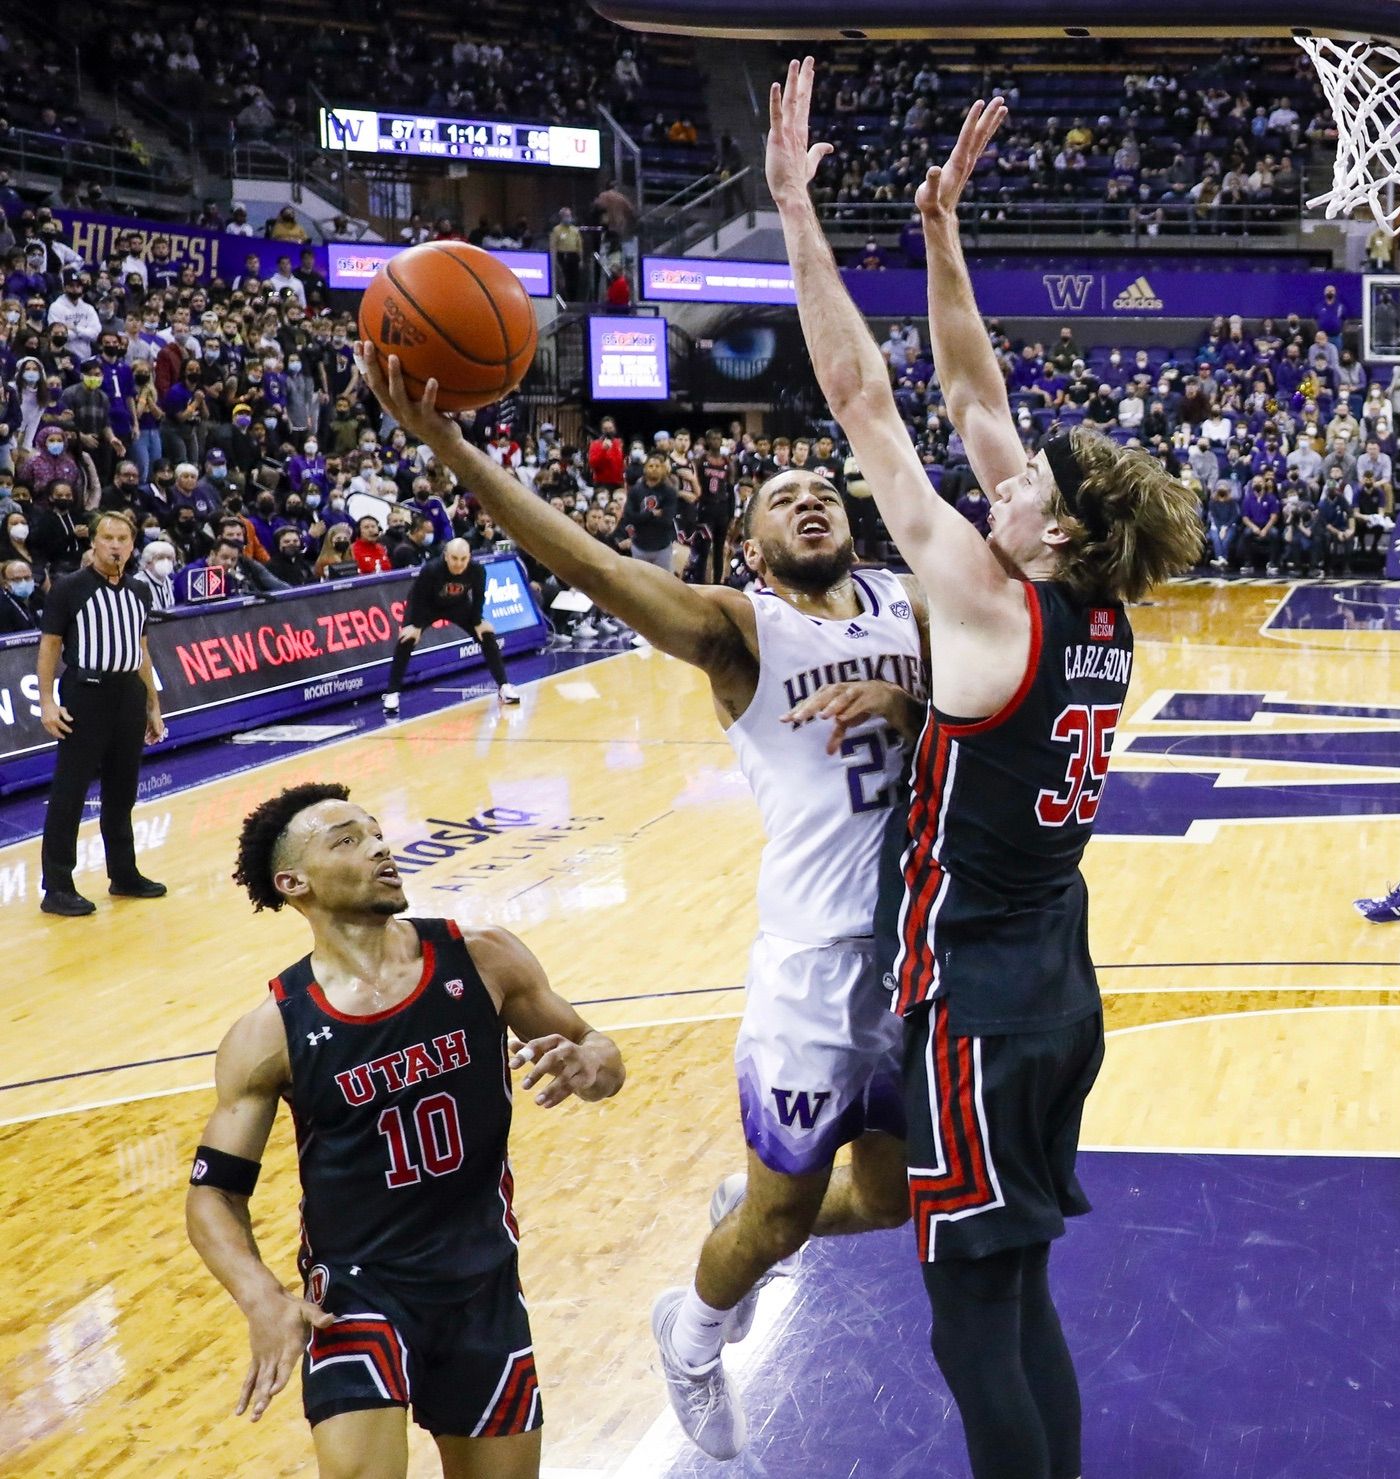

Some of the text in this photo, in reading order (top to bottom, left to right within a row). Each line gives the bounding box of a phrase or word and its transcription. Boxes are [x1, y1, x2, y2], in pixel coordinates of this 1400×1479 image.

[392, 120, 414, 139] 57
[447, 123, 487, 145] 1:14
[1043, 275, 1094, 311] W
[1112, 297, 1163, 310] adidas
[1090, 623, 1114, 637] RACISM
[1094, 611, 1108, 624] END
[175, 631, 258, 686] NEW
[317, 606, 391, 653] ZERO
[1065, 645, 1132, 684] CARLSON
[304, 682, 333, 701] ROCKET
[333, 677, 363, 693] Mortgage
[1034, 703, 1123, 827] 35
[391, 807, 543, 874] laska
[431, 816, 605, 892] AIRLINES
[334, 1029, 471, 1107] UTAH
[770, 1087, 831, 1129] W
[377, 1091, 464, 1189] 10
